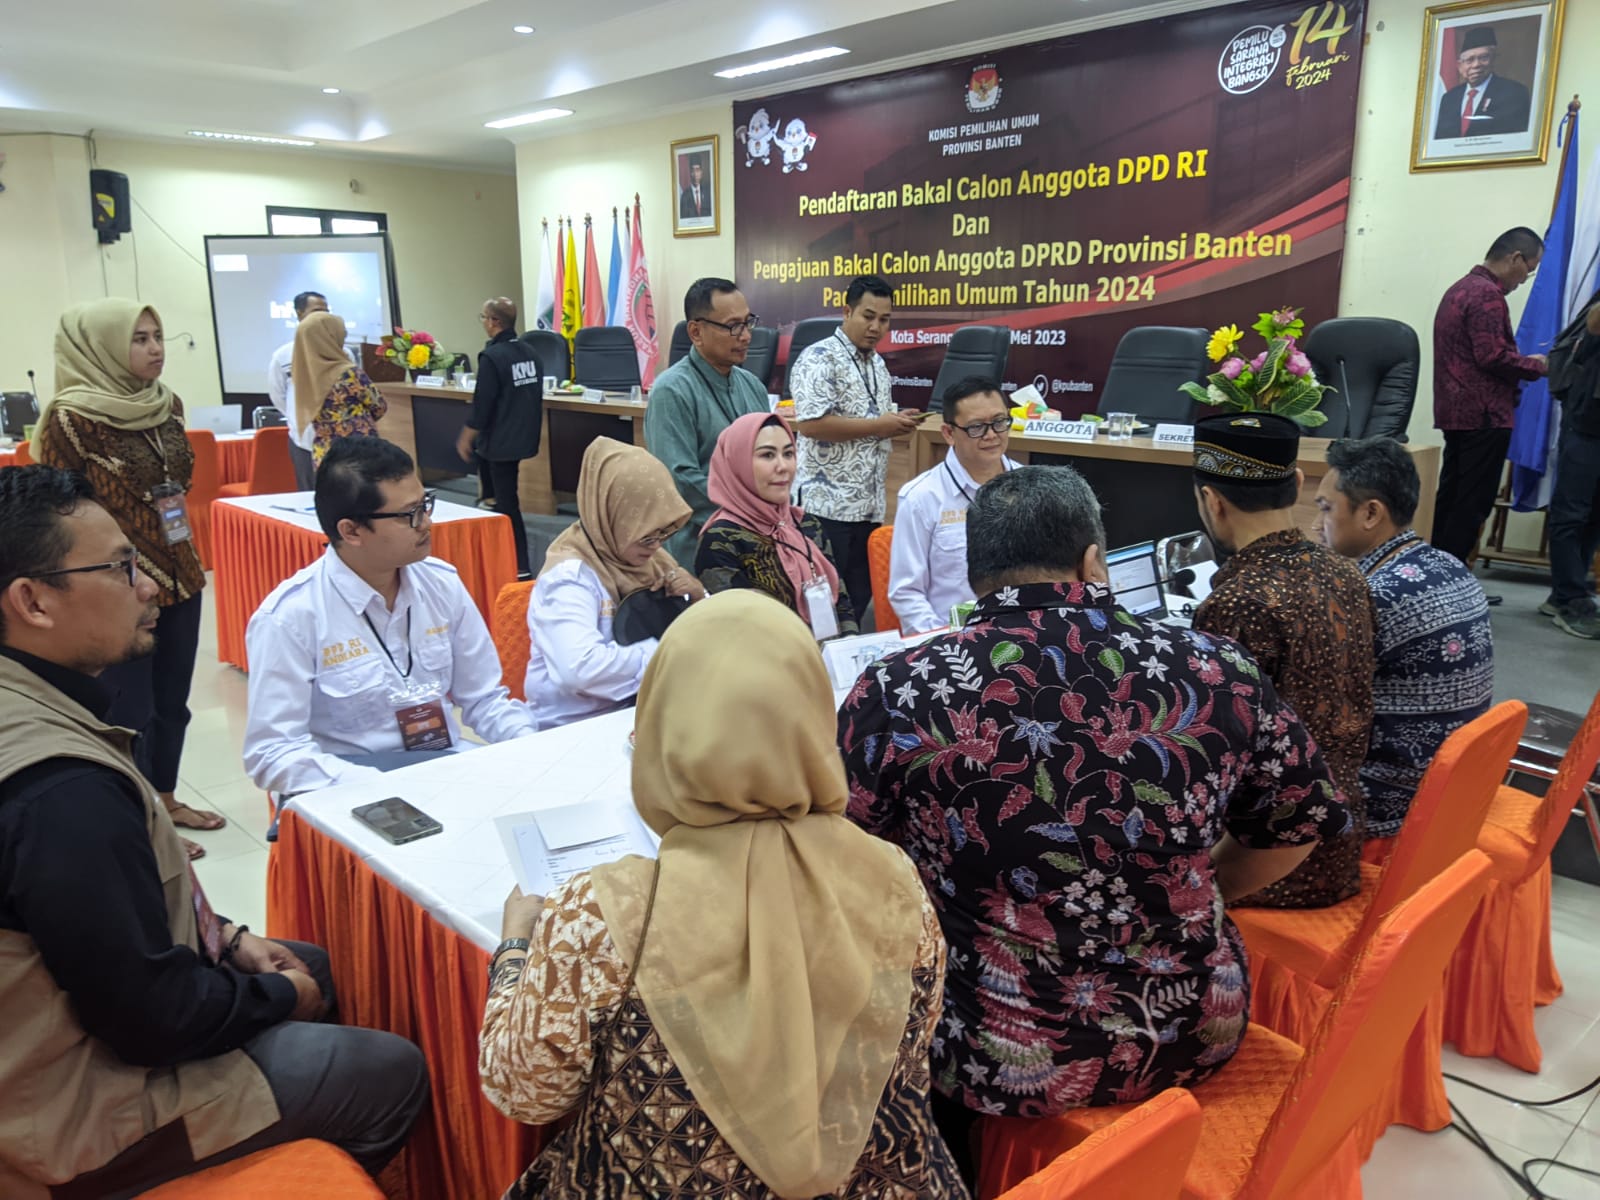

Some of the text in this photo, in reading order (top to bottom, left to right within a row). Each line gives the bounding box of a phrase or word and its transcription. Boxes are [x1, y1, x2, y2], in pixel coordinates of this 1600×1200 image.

[1232, 30, 1269, 52] PEMILU
[1289, 1, 1353, 65] 14
[1230, 43, 1269, 64] SARANA
[1223, 52, 1274, 79] INTEGRASI
[1228, 66, 1268, 89] BANGSA
[1295, 68, 1332, 90] 2024
[928, 114, 1040, 142] KOMISI PEMILIHAN UMUM
[942, 134, 1022, 157] PROVINSI BANTEN
[799, 149, 1208, 217] Pendaftaran Bakal Calon Anggota DPD RI
[952, 213, 990, 237] Dan
[753, 230, 1292, 283] Pengajuan Bakal Calon Anggota DPRD Provinsi Banten
[956, 282, 1018, 305] Umum
[1023, 278, 1089, 304] Tahun
[1096, 275, 1156, 302] 2024
[890, 330, 914, 344] Kota
[1010, 330, 1031, 345] Mei
[1034, 330, 1066, 345] 2023
[512, 360, 536, 380] KPU
[1025, 422, 1092, 436] ANGGOTA
